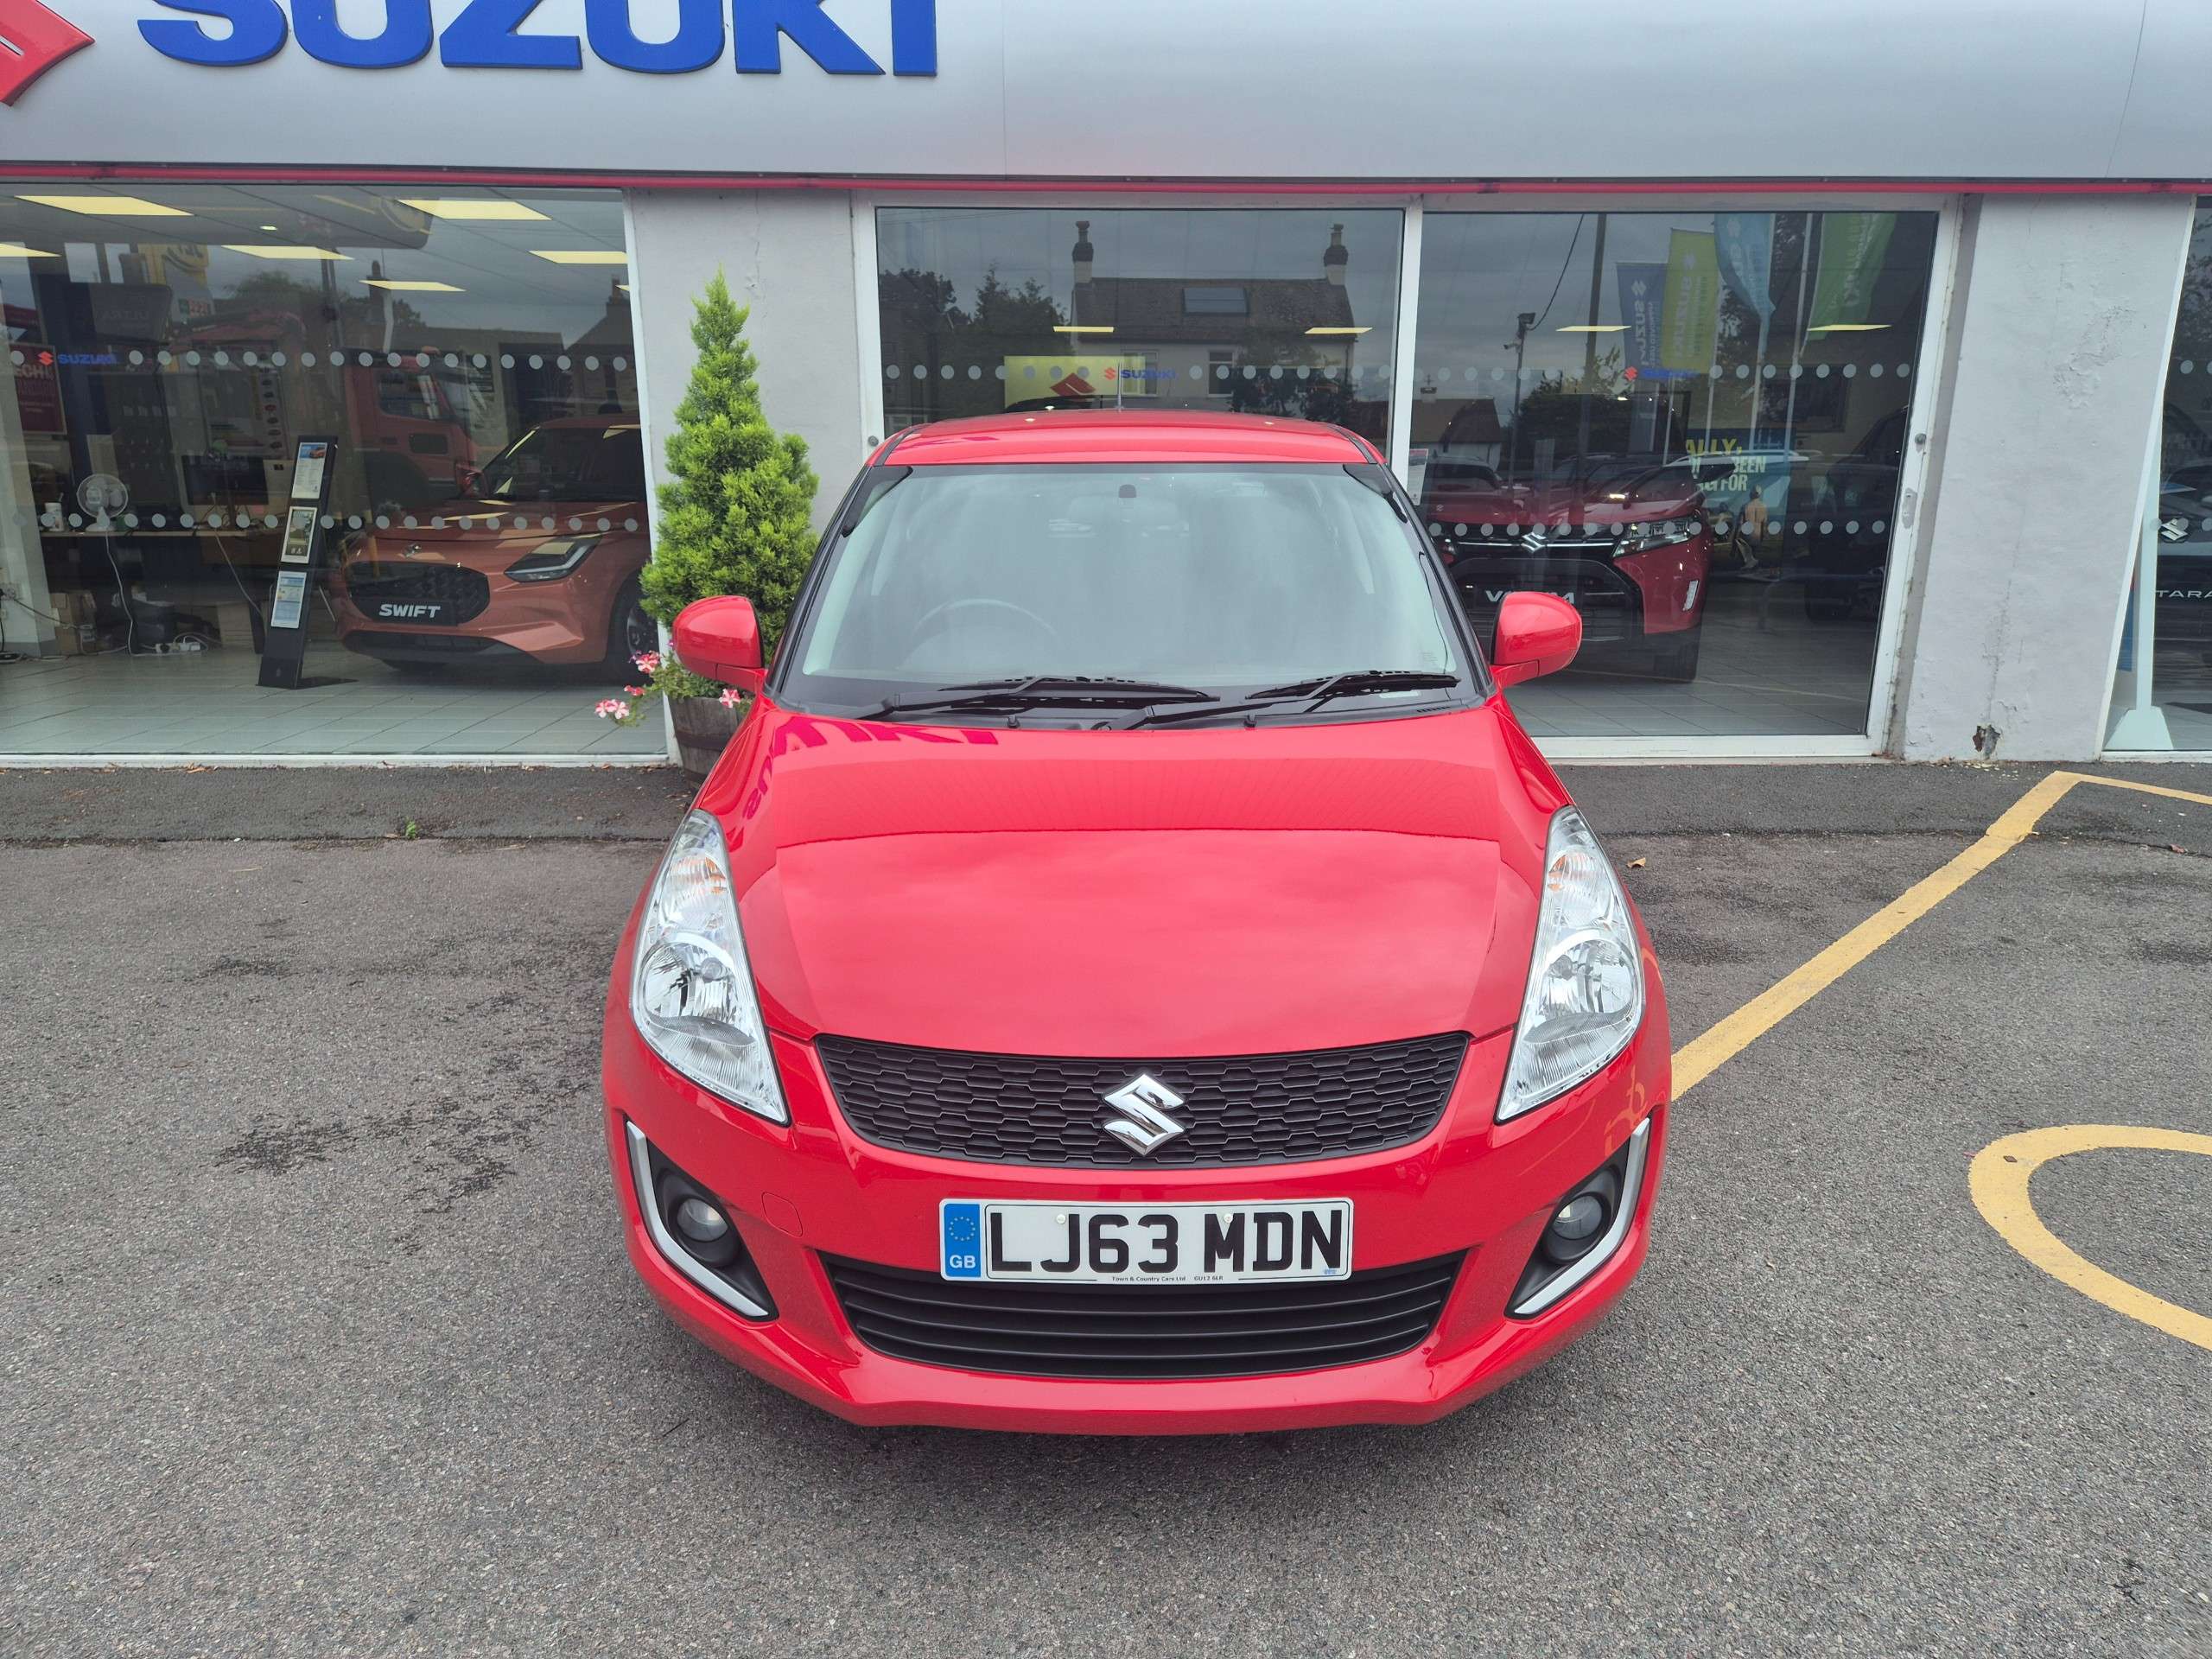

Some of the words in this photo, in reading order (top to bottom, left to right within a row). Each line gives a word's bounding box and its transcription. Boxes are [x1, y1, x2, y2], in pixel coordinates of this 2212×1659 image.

[137, 0, 938, 77] SUZUKI
[378, 603, 442, 619] SWIFT
[990, 1212, 1179, 1273] LJ63
[1204, 1210, 1343, 1272] MDN
[949, 1255, 976, 1268] GB
